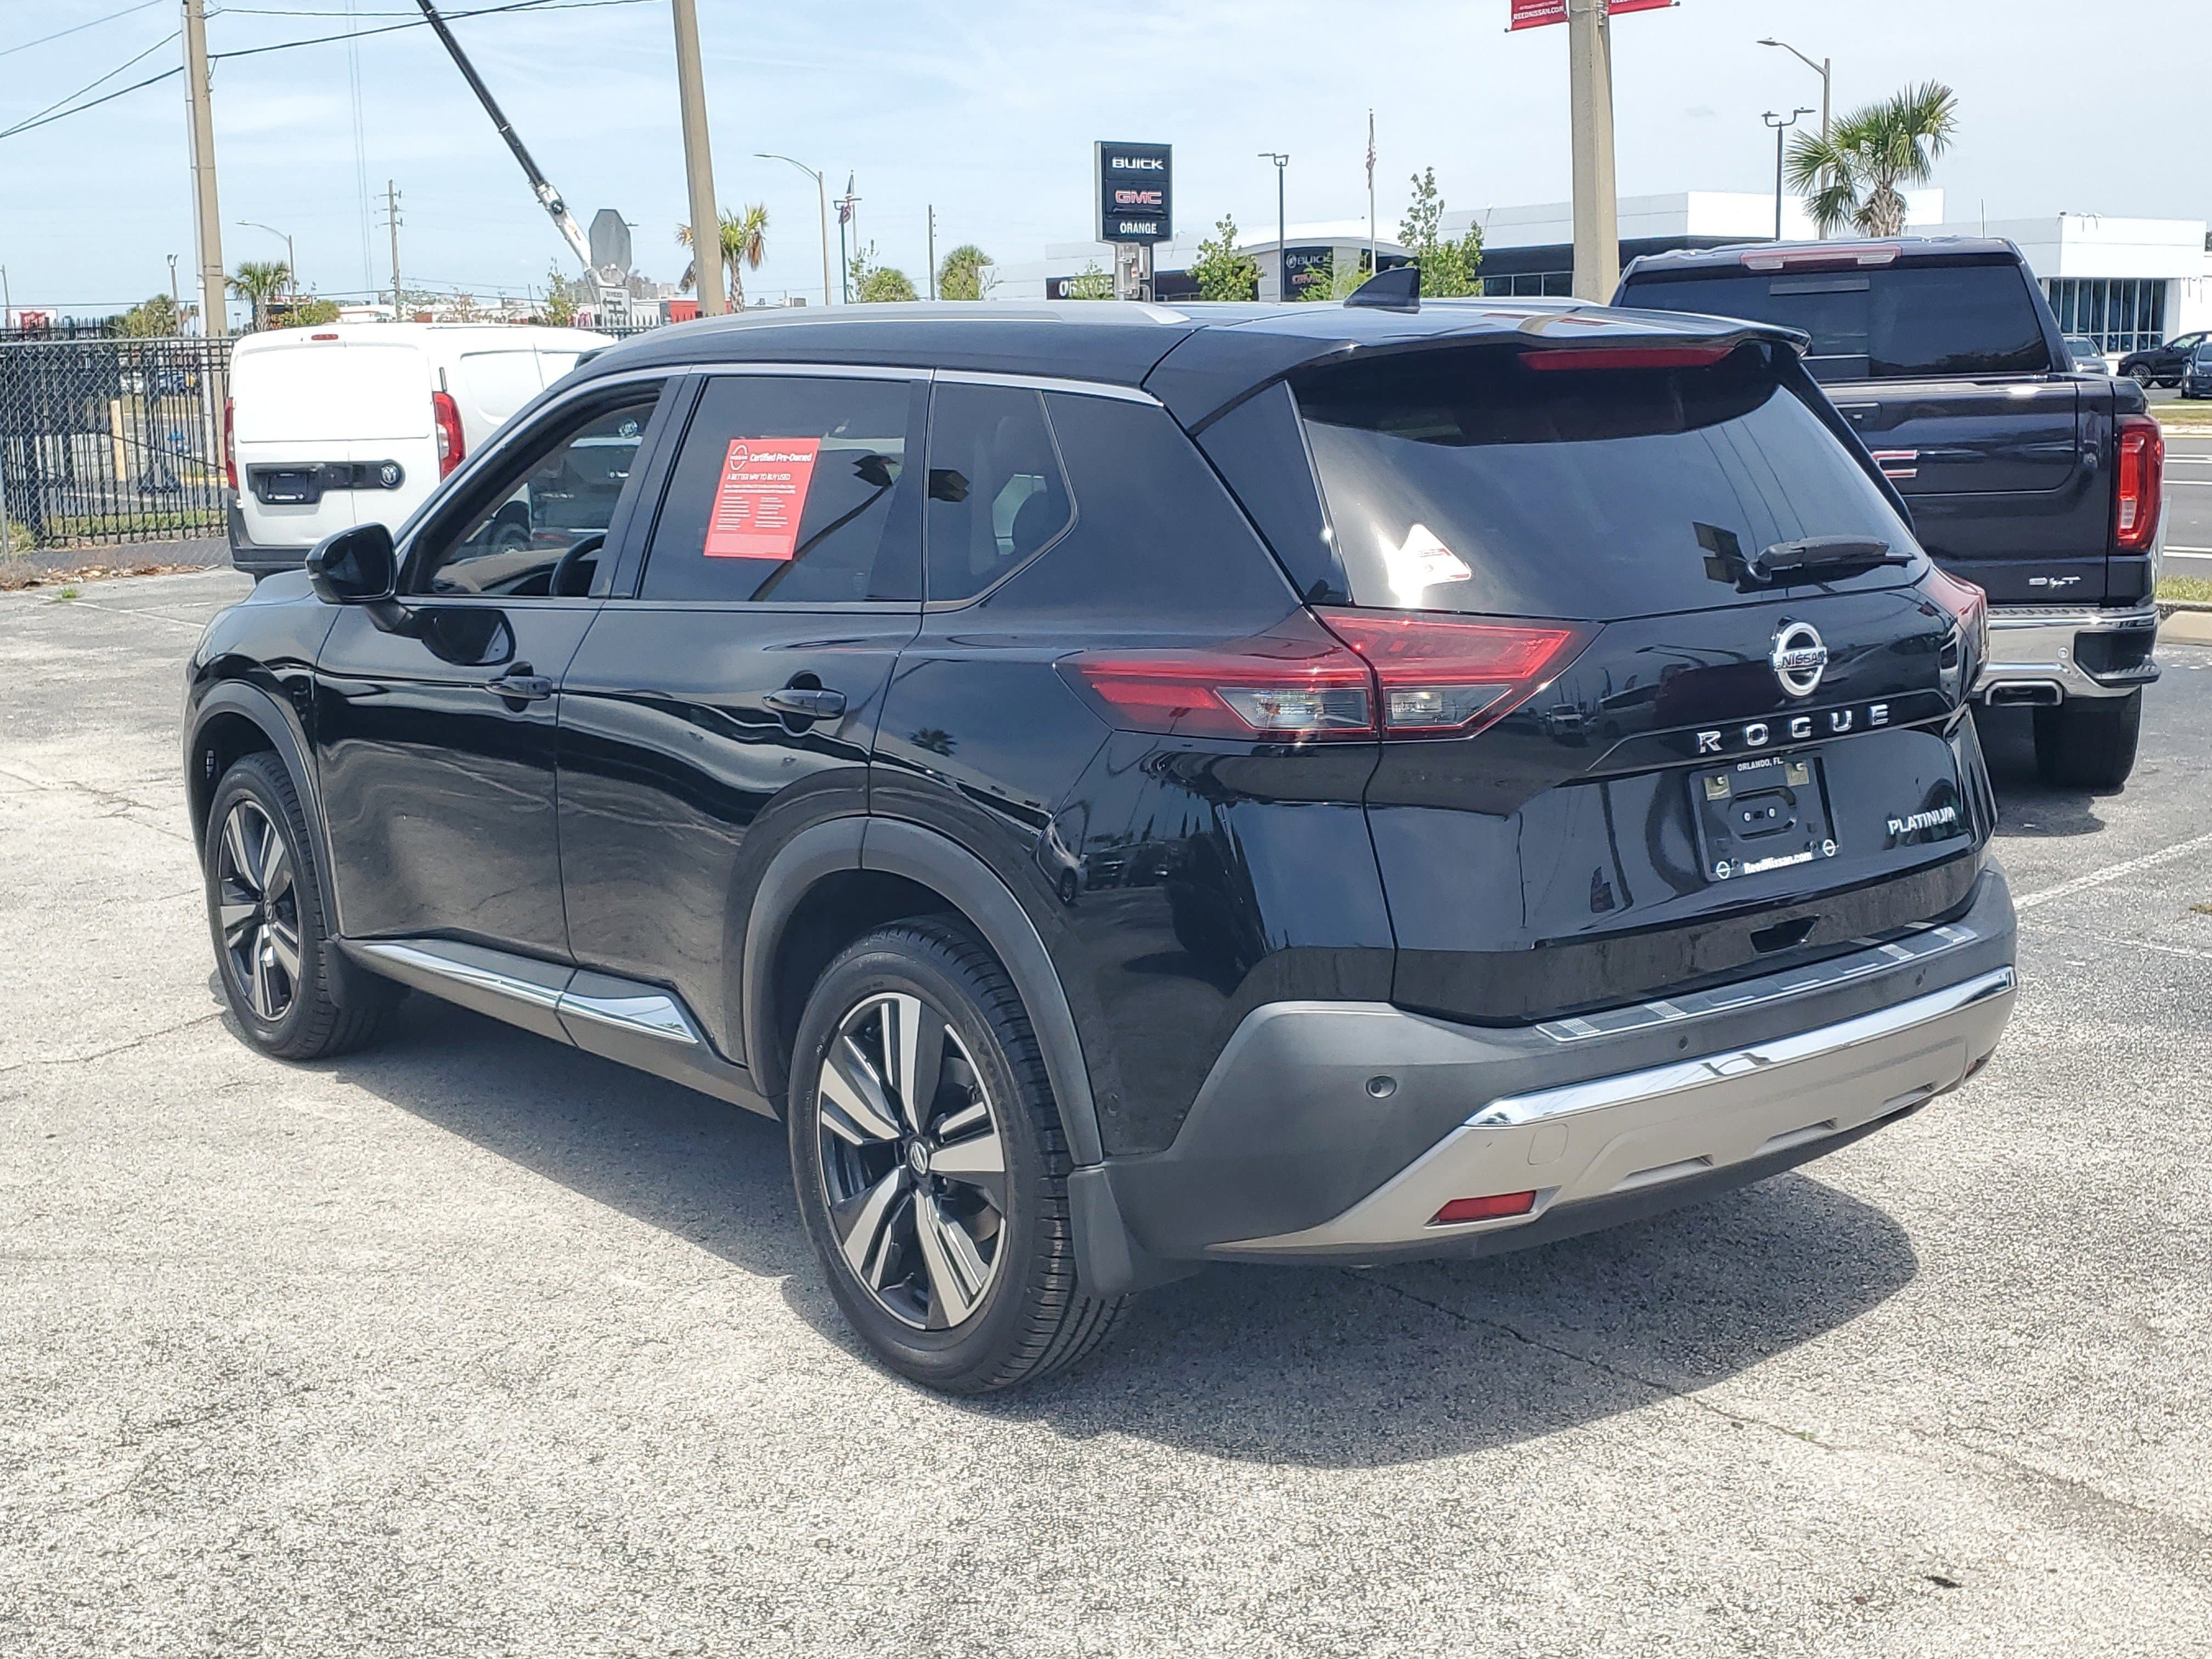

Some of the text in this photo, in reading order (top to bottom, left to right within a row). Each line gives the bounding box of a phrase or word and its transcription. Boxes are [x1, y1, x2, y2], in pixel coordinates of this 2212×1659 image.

[1112, 157, 1164, 170] BUICK
[1115, 190, 1161, 205] GMC
[1120, 222, 1157, 234] ORANGE
[749, 453, 813, 462] Certified Pre-Owned
[1782, 651, 1826, 667] NISSAN
[1697, 704, 1889, 753] ROGUE
[1737, 759, 1772, 771] ORLANDO,
[1887, 806, 1956, 834] PLATINUM
